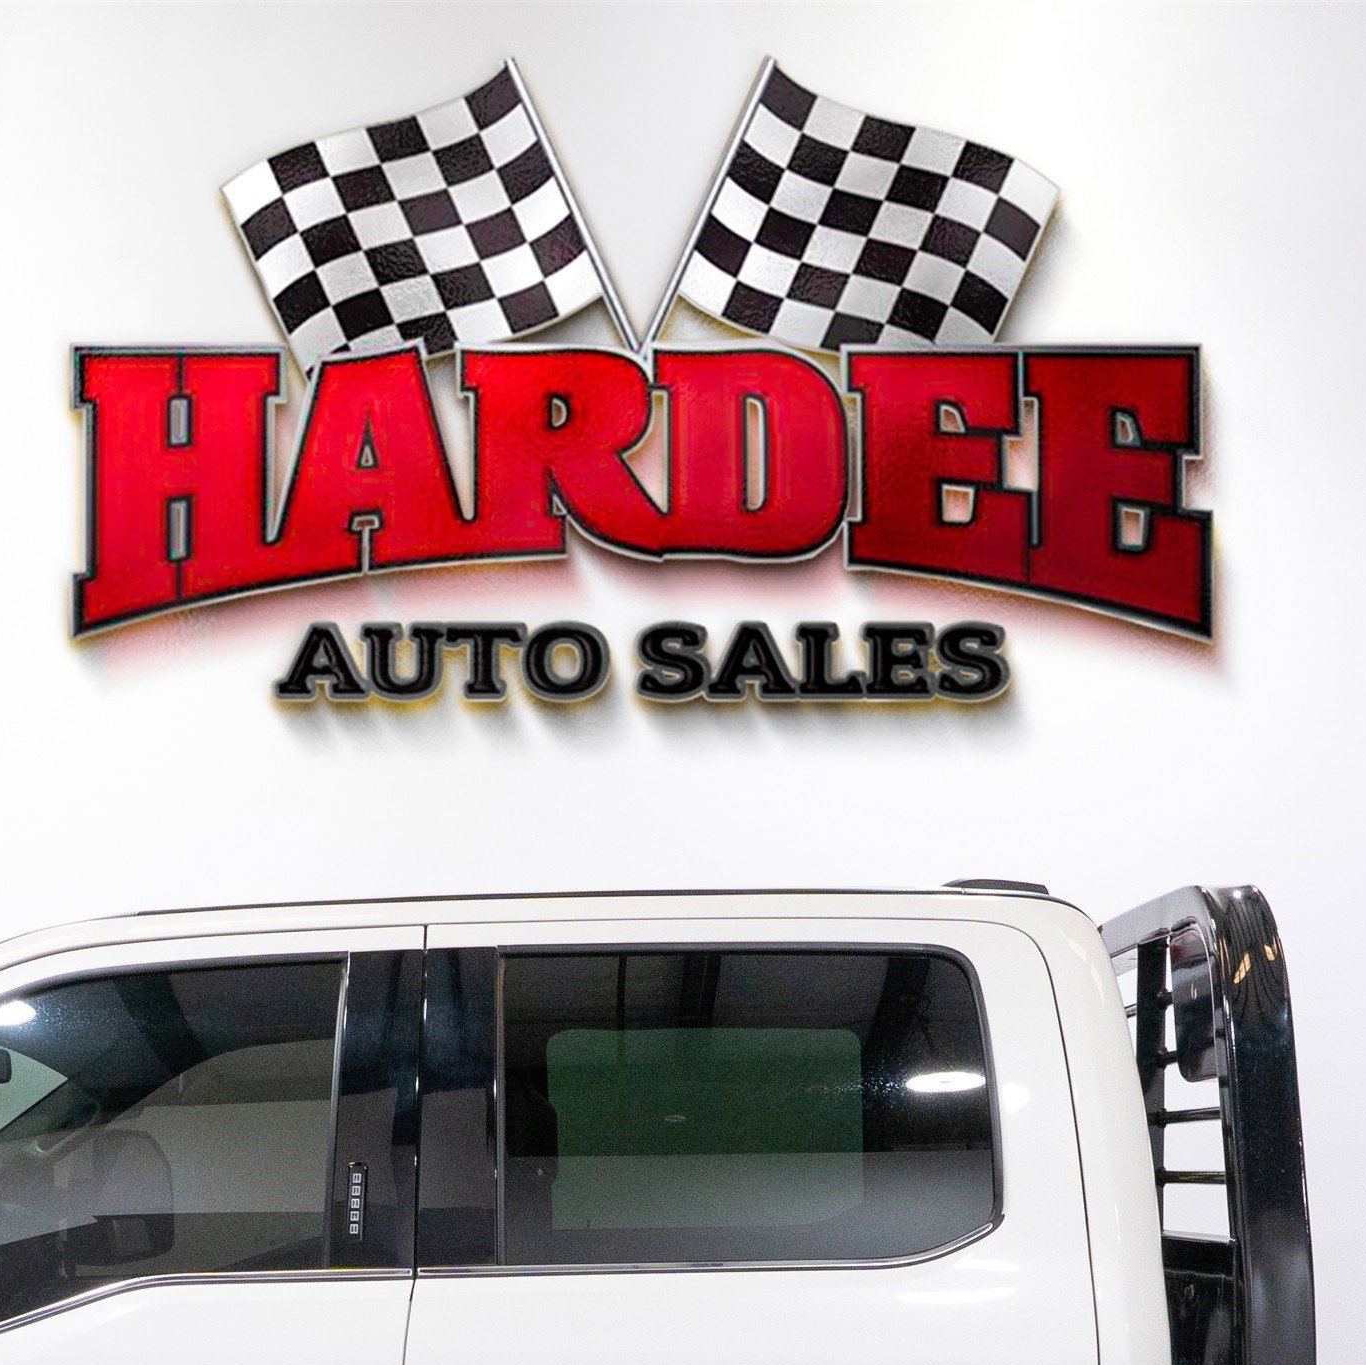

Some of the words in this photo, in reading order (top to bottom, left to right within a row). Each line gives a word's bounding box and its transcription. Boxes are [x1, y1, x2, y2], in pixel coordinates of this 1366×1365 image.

[71, 343, 1215, 640] HARDEE
[276, 622, 607, 699] AUTO
[636, 622, 1009, 699] SALES
